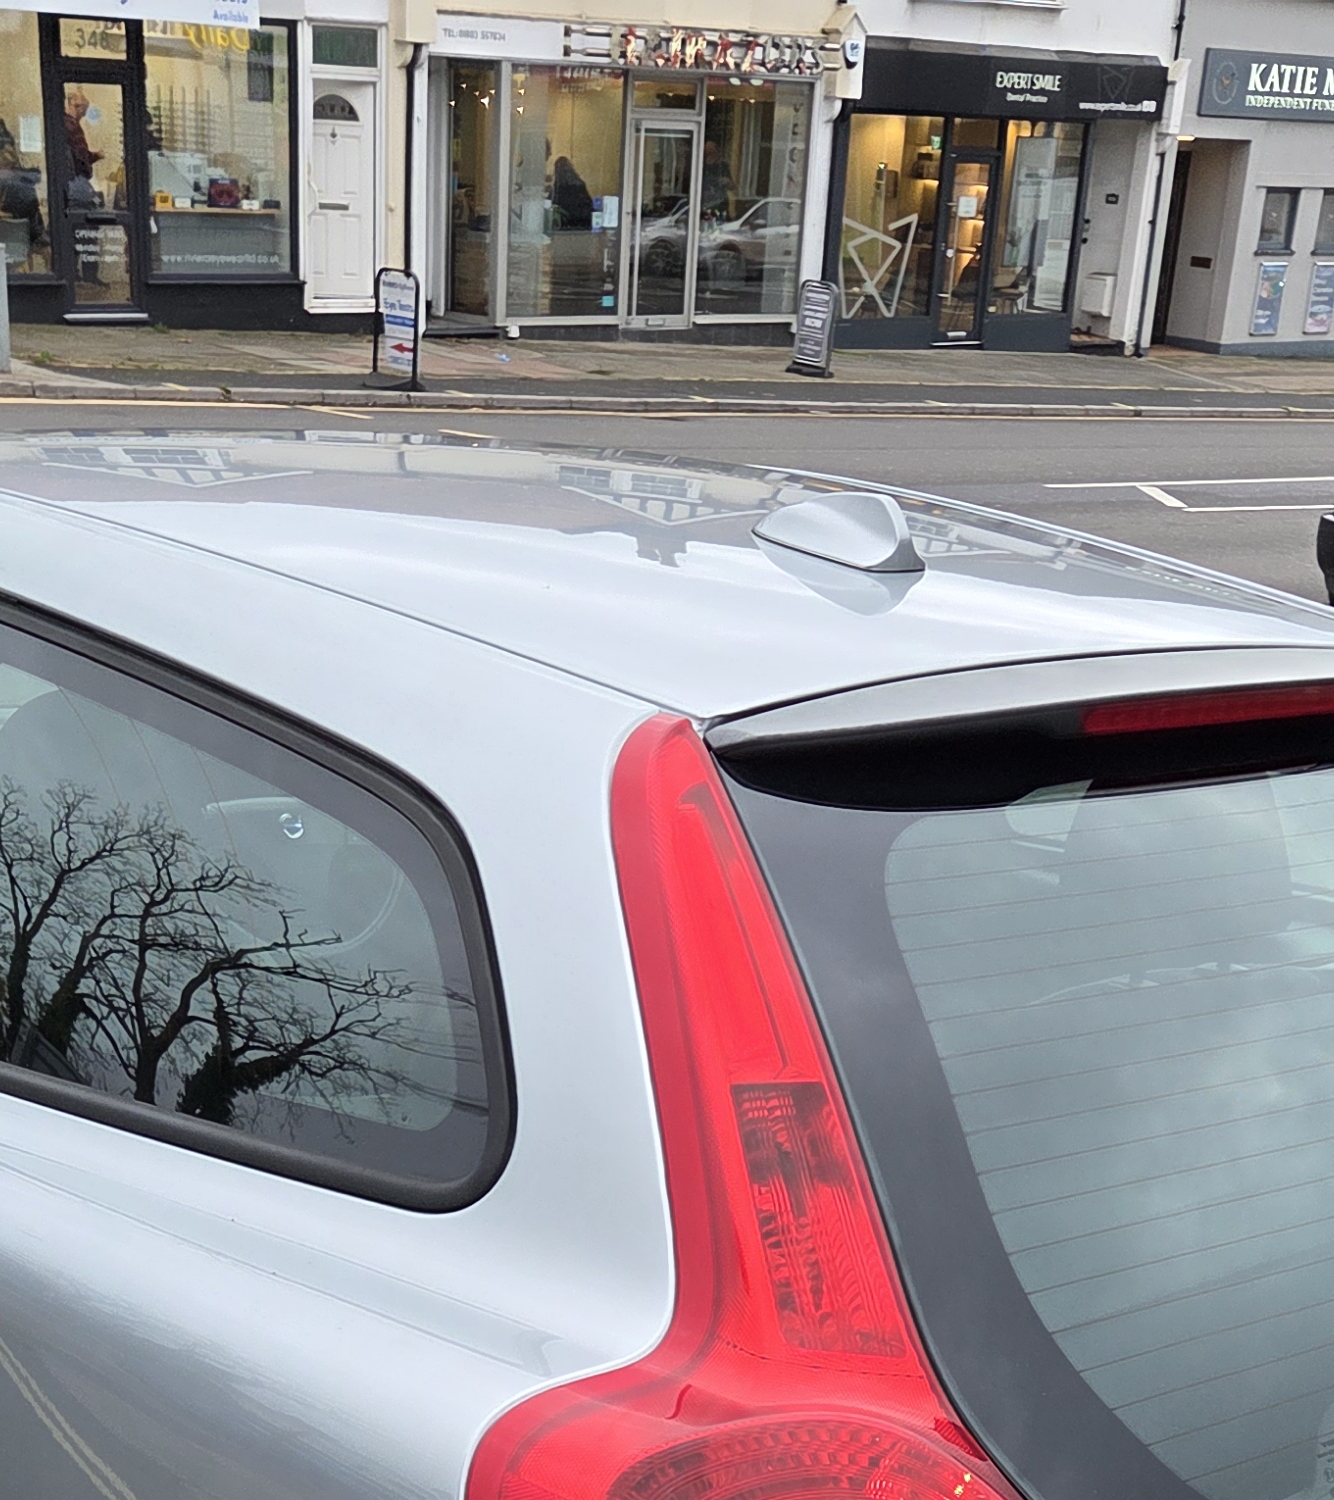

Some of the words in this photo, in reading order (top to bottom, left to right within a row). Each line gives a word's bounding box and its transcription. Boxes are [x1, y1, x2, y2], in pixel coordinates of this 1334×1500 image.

[995, 71, 1032, 90] EXPERT
[1032, 74, 1062, 92] SMILE
[1247, 63, 1319, 95] KATIE
[1245, 94, 1312, 111] INDEPENDENT
